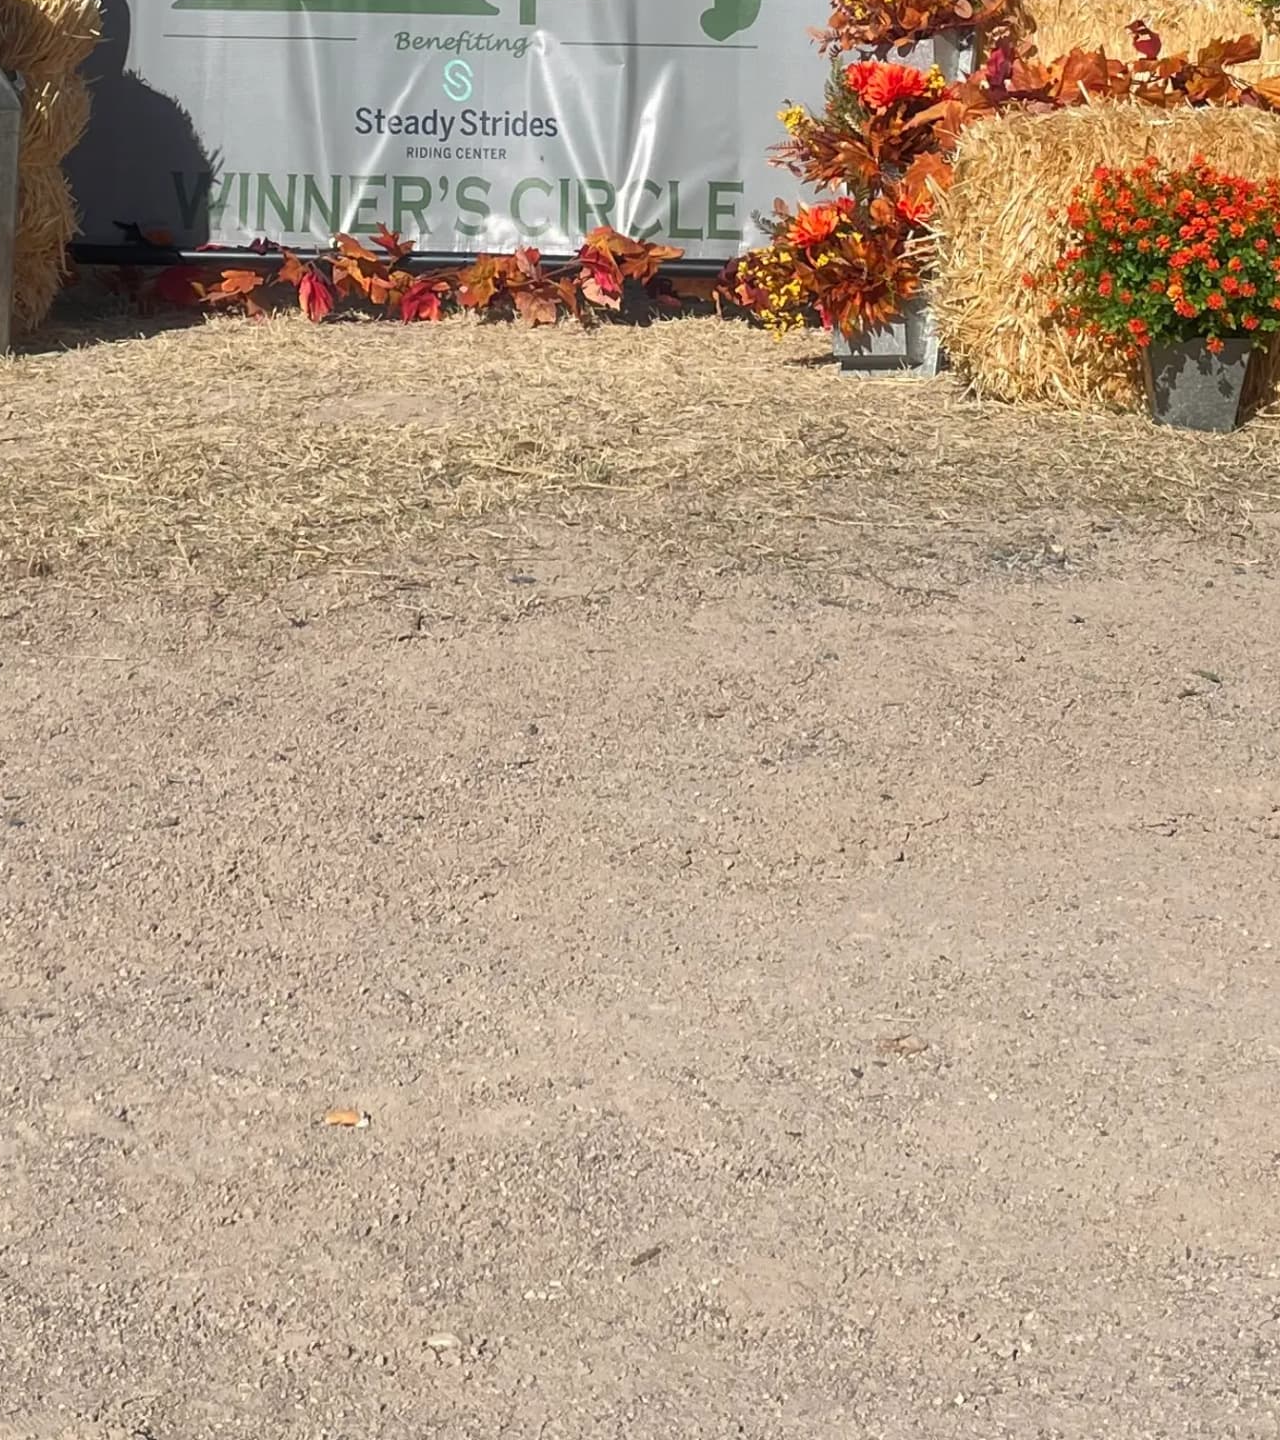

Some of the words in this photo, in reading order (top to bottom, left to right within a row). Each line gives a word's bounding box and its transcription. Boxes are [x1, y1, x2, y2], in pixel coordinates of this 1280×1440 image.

[394, 31, 532, 58] Benefiting
[355, 107, 455, 142] Steady
[460, 109, 558, 137] Strides
[407, 147, 451, 159] RIDING
[456, 148, 506, 160] CENTER
[171, 172, 492, 236] WINNER'S
[510, 177, 744, 240] CIRCLE
